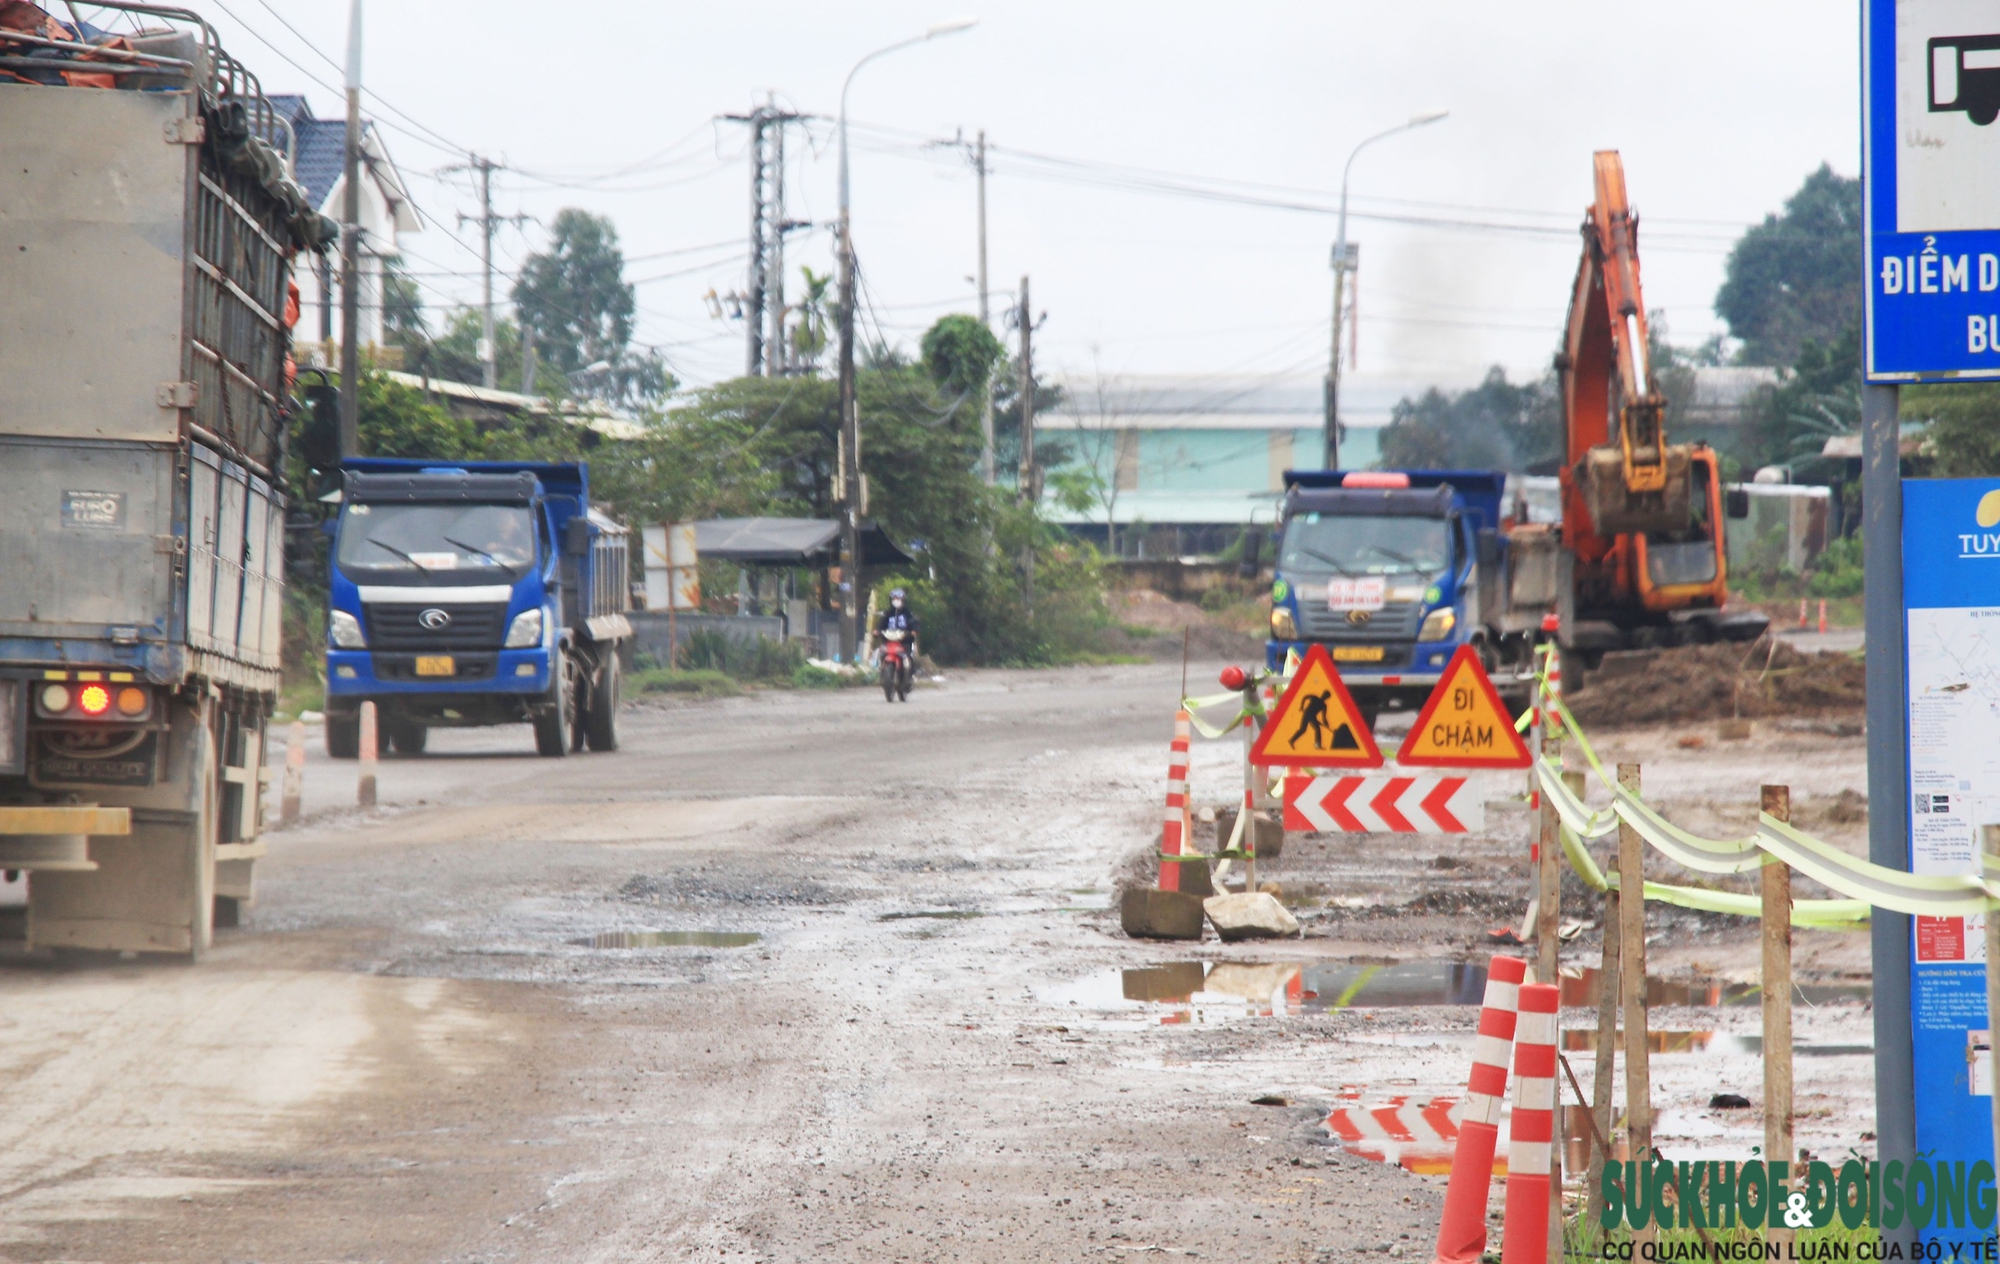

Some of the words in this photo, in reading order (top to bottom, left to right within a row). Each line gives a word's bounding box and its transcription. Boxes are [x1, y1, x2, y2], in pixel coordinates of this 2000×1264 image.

[1880, 235, 1969, 294] ĐIỂM
[1958, 534, 2000, 553] TUY
[1453, 688, 1474, 711] ĐI
[1432, 719, 1494, 753] CHẬM
